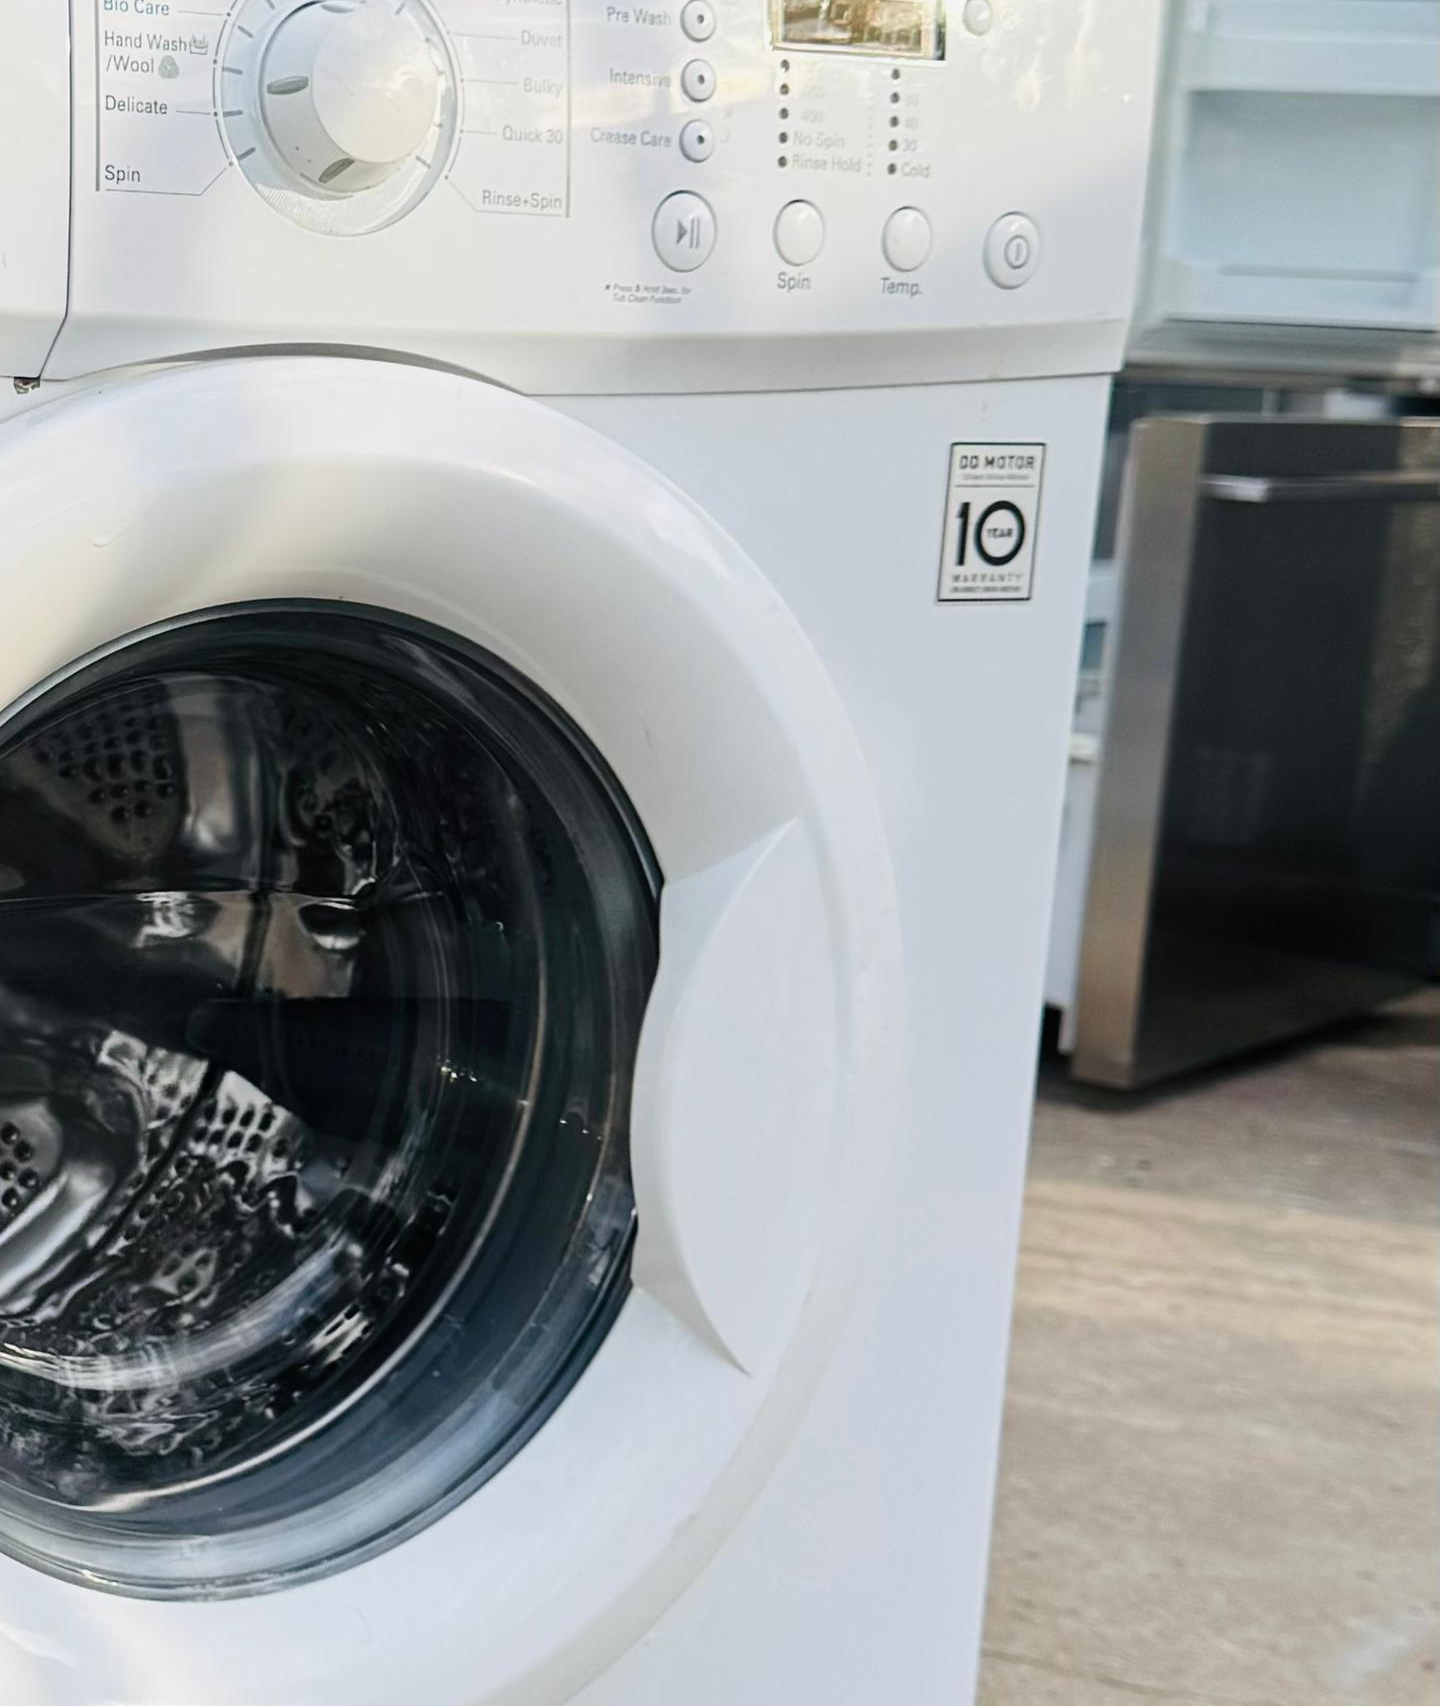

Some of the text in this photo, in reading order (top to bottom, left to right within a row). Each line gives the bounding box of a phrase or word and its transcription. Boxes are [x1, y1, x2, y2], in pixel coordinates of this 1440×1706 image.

[607, 6, 672, 26] Pre Wash
[104, 30, 187, 52] Hand Wash
[521, 29, 563, 48] Duvet
[105, 54, 155, 74] /Wool
[523, 77, 563, 99] Bulky
[610, 69, 672, 87] Intensive
[105, 95, 168, 115] Delicate
[502, 125, 563, 144] Quick 30
[590, 127, 672, 148] Crease Care
[793, 132, 845, 149] No Spin
[105, 165, 140, 184] Spin
[482, 190, 563, 211] Rinse+Spin
[777, 272, 810, 292] Spin
[880, 277, 923, 297] Temp.
[983, 455, 1035, 470] MOTOR
[956, 500, 1025, 567] 10
[987, 528, 1013, 538] YEAR
[952, 573, 1023, 583] WARRANTY
